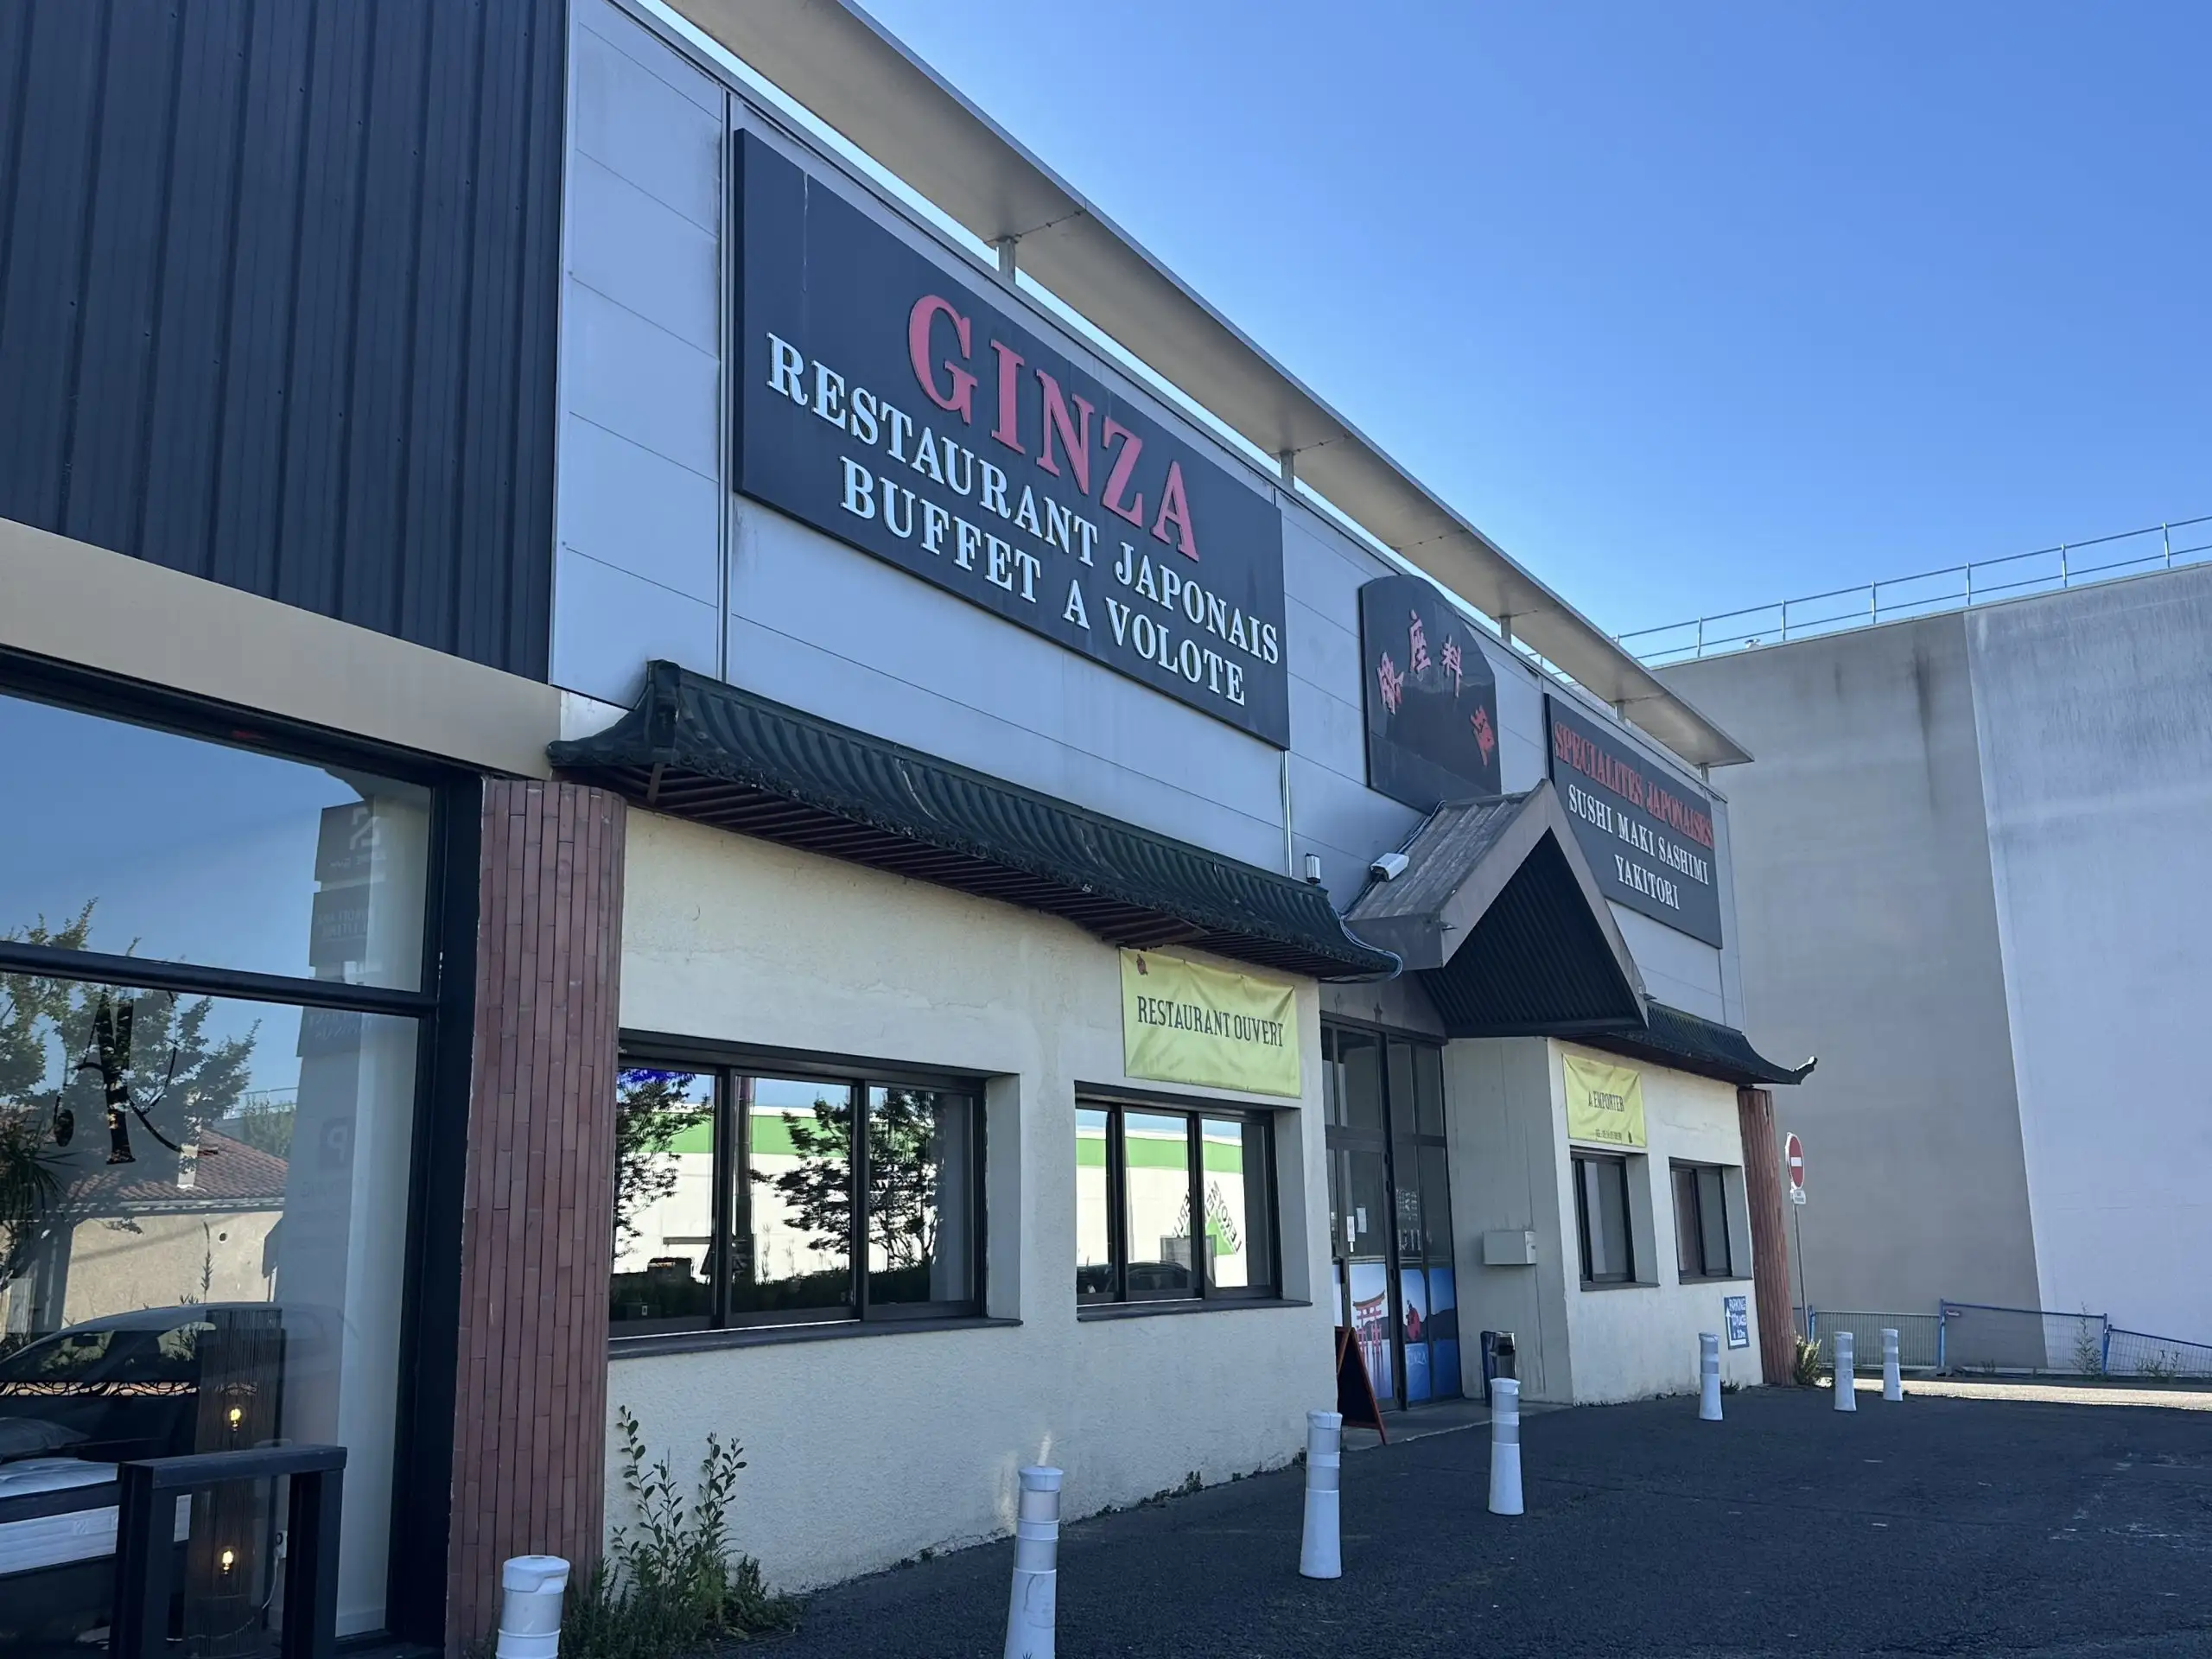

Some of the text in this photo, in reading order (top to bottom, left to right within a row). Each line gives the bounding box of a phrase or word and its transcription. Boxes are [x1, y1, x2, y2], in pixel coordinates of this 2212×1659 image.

[909, 295, 1198, 562] GINZA
[766, 333, 1278, 664] RESTAURANT JAPONAIS
[841, 455, 1245, 707] BUFFET A VOLOTE
[1568, 784, 1709, 886] SUSHI MAKI SASHIMI
[1614, 854, 1680, 910] YAKITORI
[1137, 995, 1283, 1047] RESTAURANT OUVERT
[1593, 1090, 1624, 1112] EMPORTER
